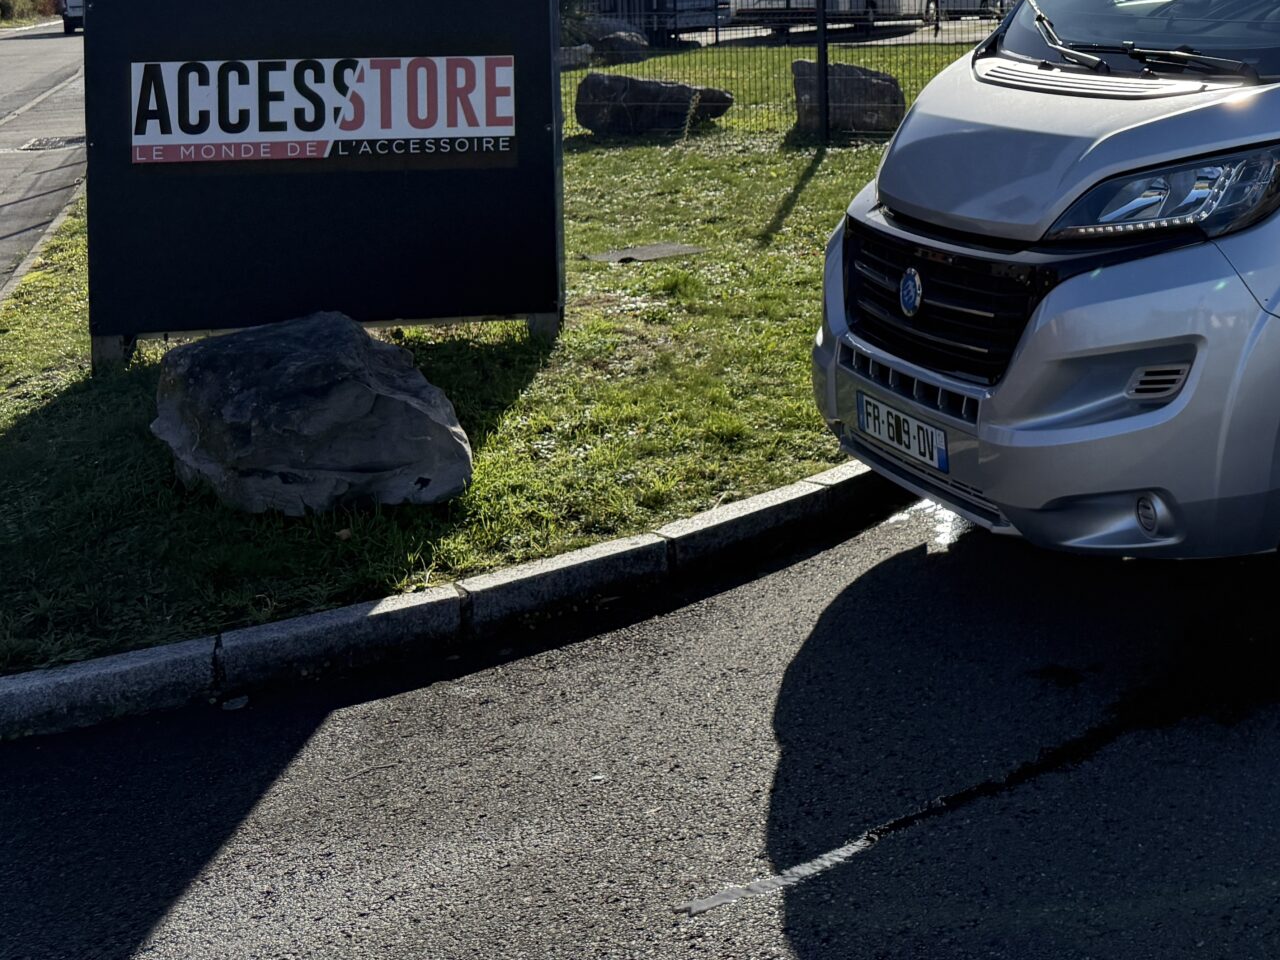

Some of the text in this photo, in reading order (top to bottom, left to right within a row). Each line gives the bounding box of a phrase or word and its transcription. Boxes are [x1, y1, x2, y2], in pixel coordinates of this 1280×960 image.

[135, 137, 512, 161] LE MONDE DE L'ACCESSOIRE
[865, 399, 935, 462] FR-69-DV
